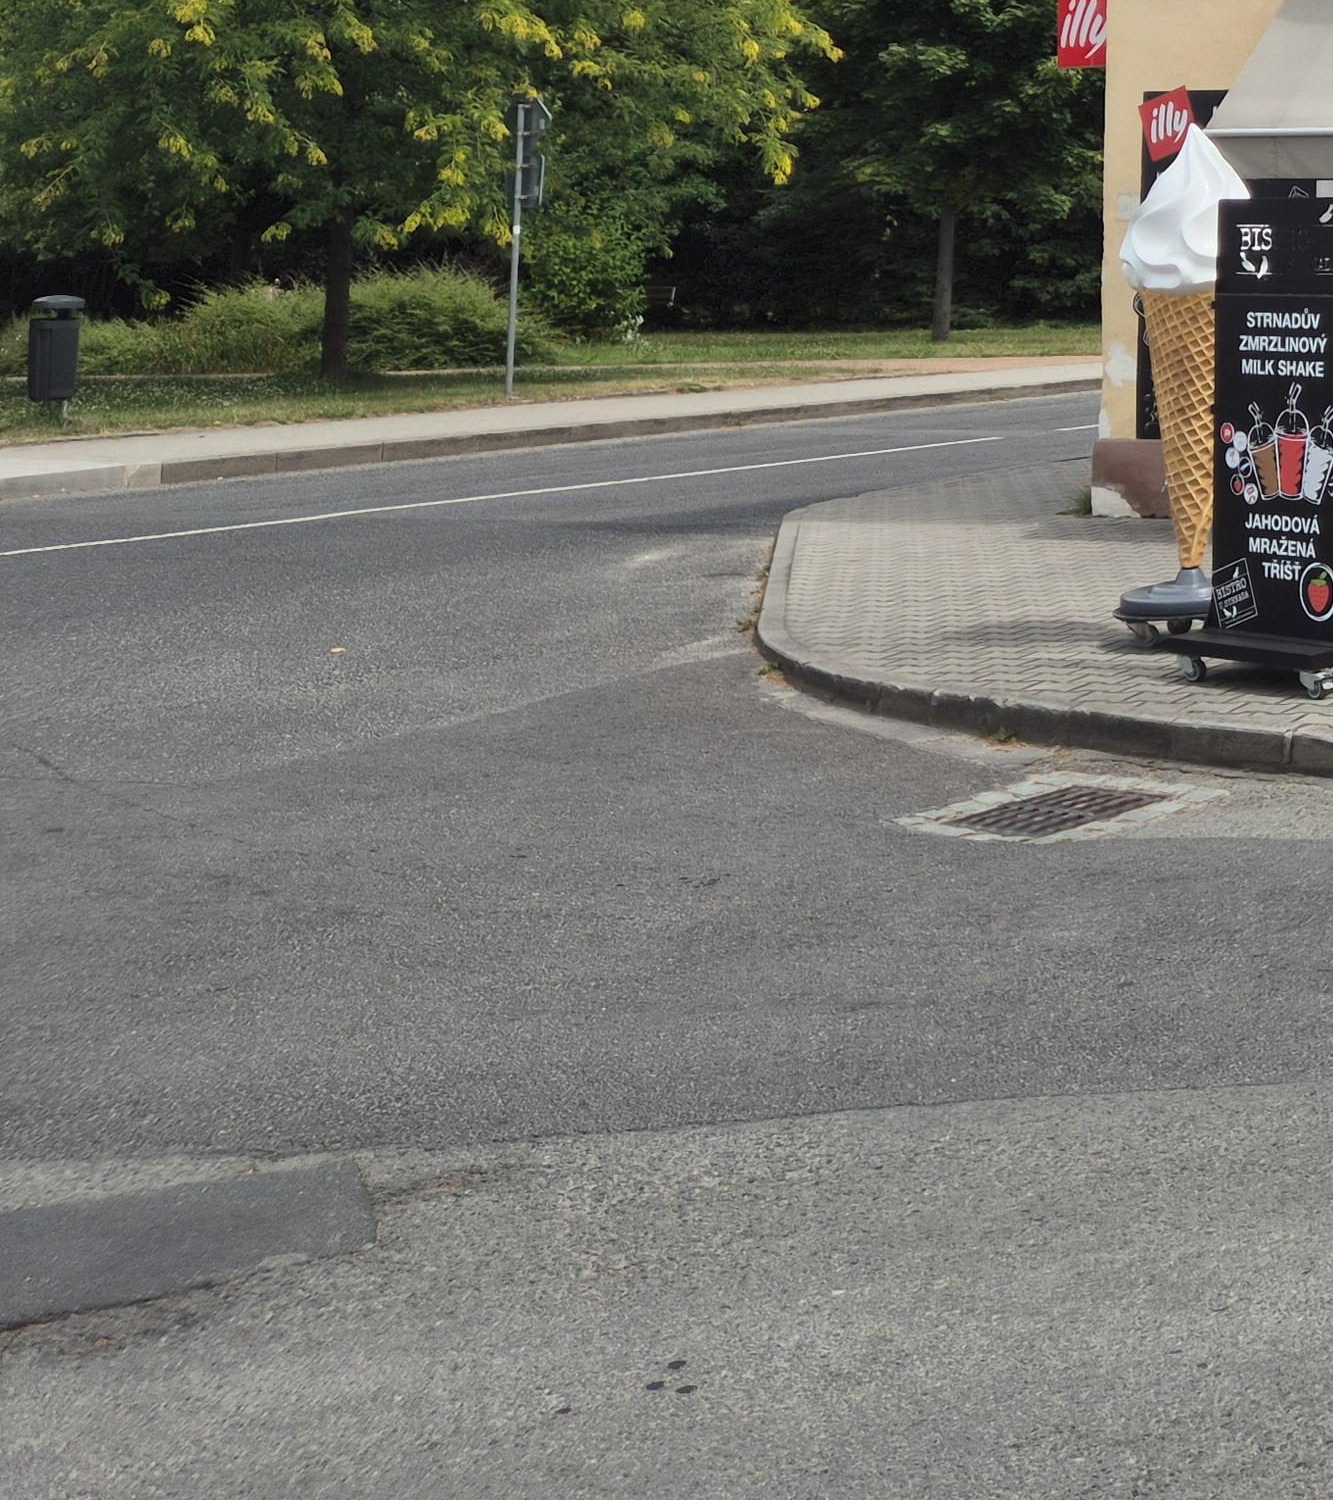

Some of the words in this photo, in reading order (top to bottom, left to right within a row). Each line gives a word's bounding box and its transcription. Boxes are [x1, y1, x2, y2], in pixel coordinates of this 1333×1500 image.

[1150, 101, 1189, 144] illy
[1246, 307, 1321, 330] STRNADŮV
[1239, 333, 1328, 354] ZMRZLINOVÝ
[1241, 358, 1275, 376] MILK
[1277, 360, 1325, 378] SHAKE
[1244, 512, 1320, 535] JAHODOVÁ
[1248, 536, 1316, 559] MRAŽENÁ
